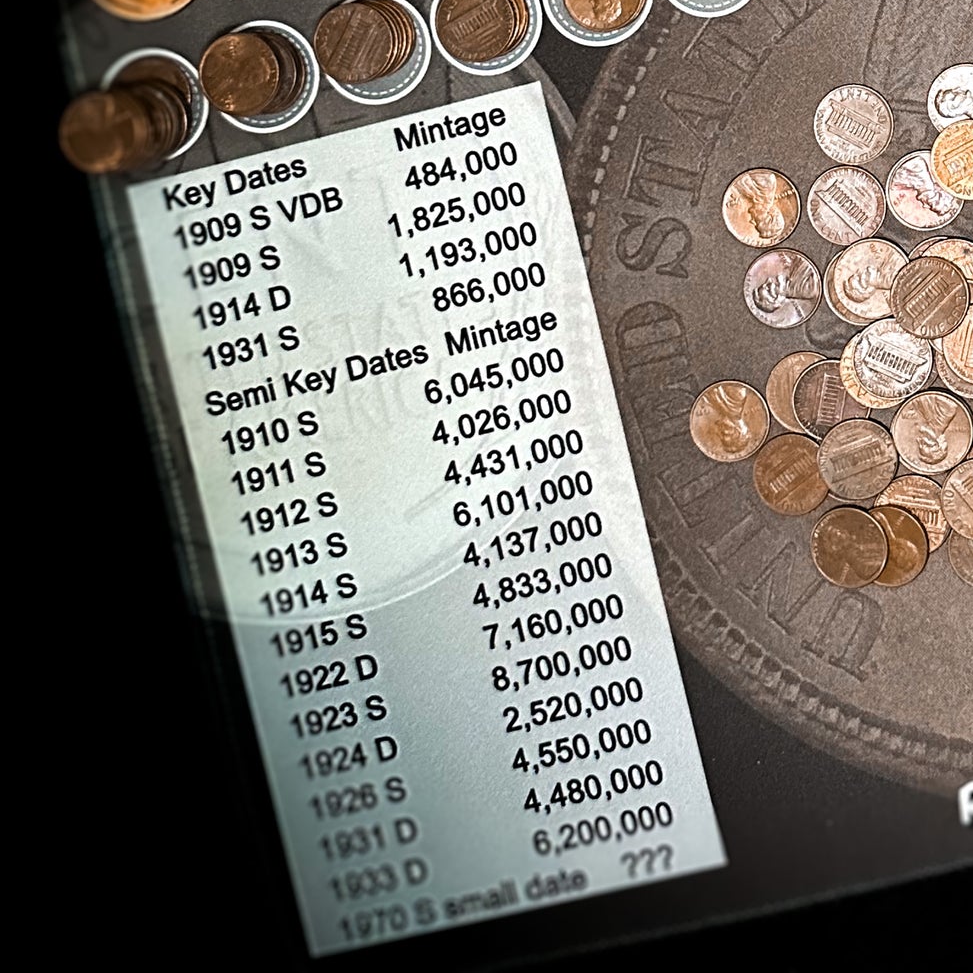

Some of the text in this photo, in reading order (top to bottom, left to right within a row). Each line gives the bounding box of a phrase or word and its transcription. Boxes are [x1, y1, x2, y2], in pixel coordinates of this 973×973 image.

[163, 108, 506, 211] Key Dates Mintage
[174, 142, 517, 249] 1909 S VDB 484,000
[184, 182, 525, 289] 1909 S 1,825,000
[193, 222, 536, 329] 1914 D 1,193,000
[202, 263, 545, 370] 1931 S 866,000
[205, 312, 557, 416] Semi Key Dates Mintage
[221, 348, 564, 455] 1910 S 6,045,000
[231, 390, 571, 495] 1911 S 4,026,000
[241, 429, 583, 535] 1912 S 4,431,000
[251, 471, 592, 576] 1913 S 6,101,000
[261, 512, 602, 616] 1914 S 4,137,000
[271, 553, 612, 657] 1915 S 4,833,000
[281, 594, 623, 697] 1922 D 7,160,000
[291, 636, 631, 738] 1923 S 8,700,000
[301, 677, 643, 778] 1924 D 2,520,000
[385, 777, 406, 803] S
[512, 719, 651, 775] 4,550,000
[394, 818, 417, 844] D
[524, 760, 663, 815] 4,480,000
[404, 859, 427, 885] D
[533, 802, 673, 855] 6,200,000
[445, 880, 519, 920] small
[524, 870, 590, 900] date
[621, 844, 673, 874] ???
